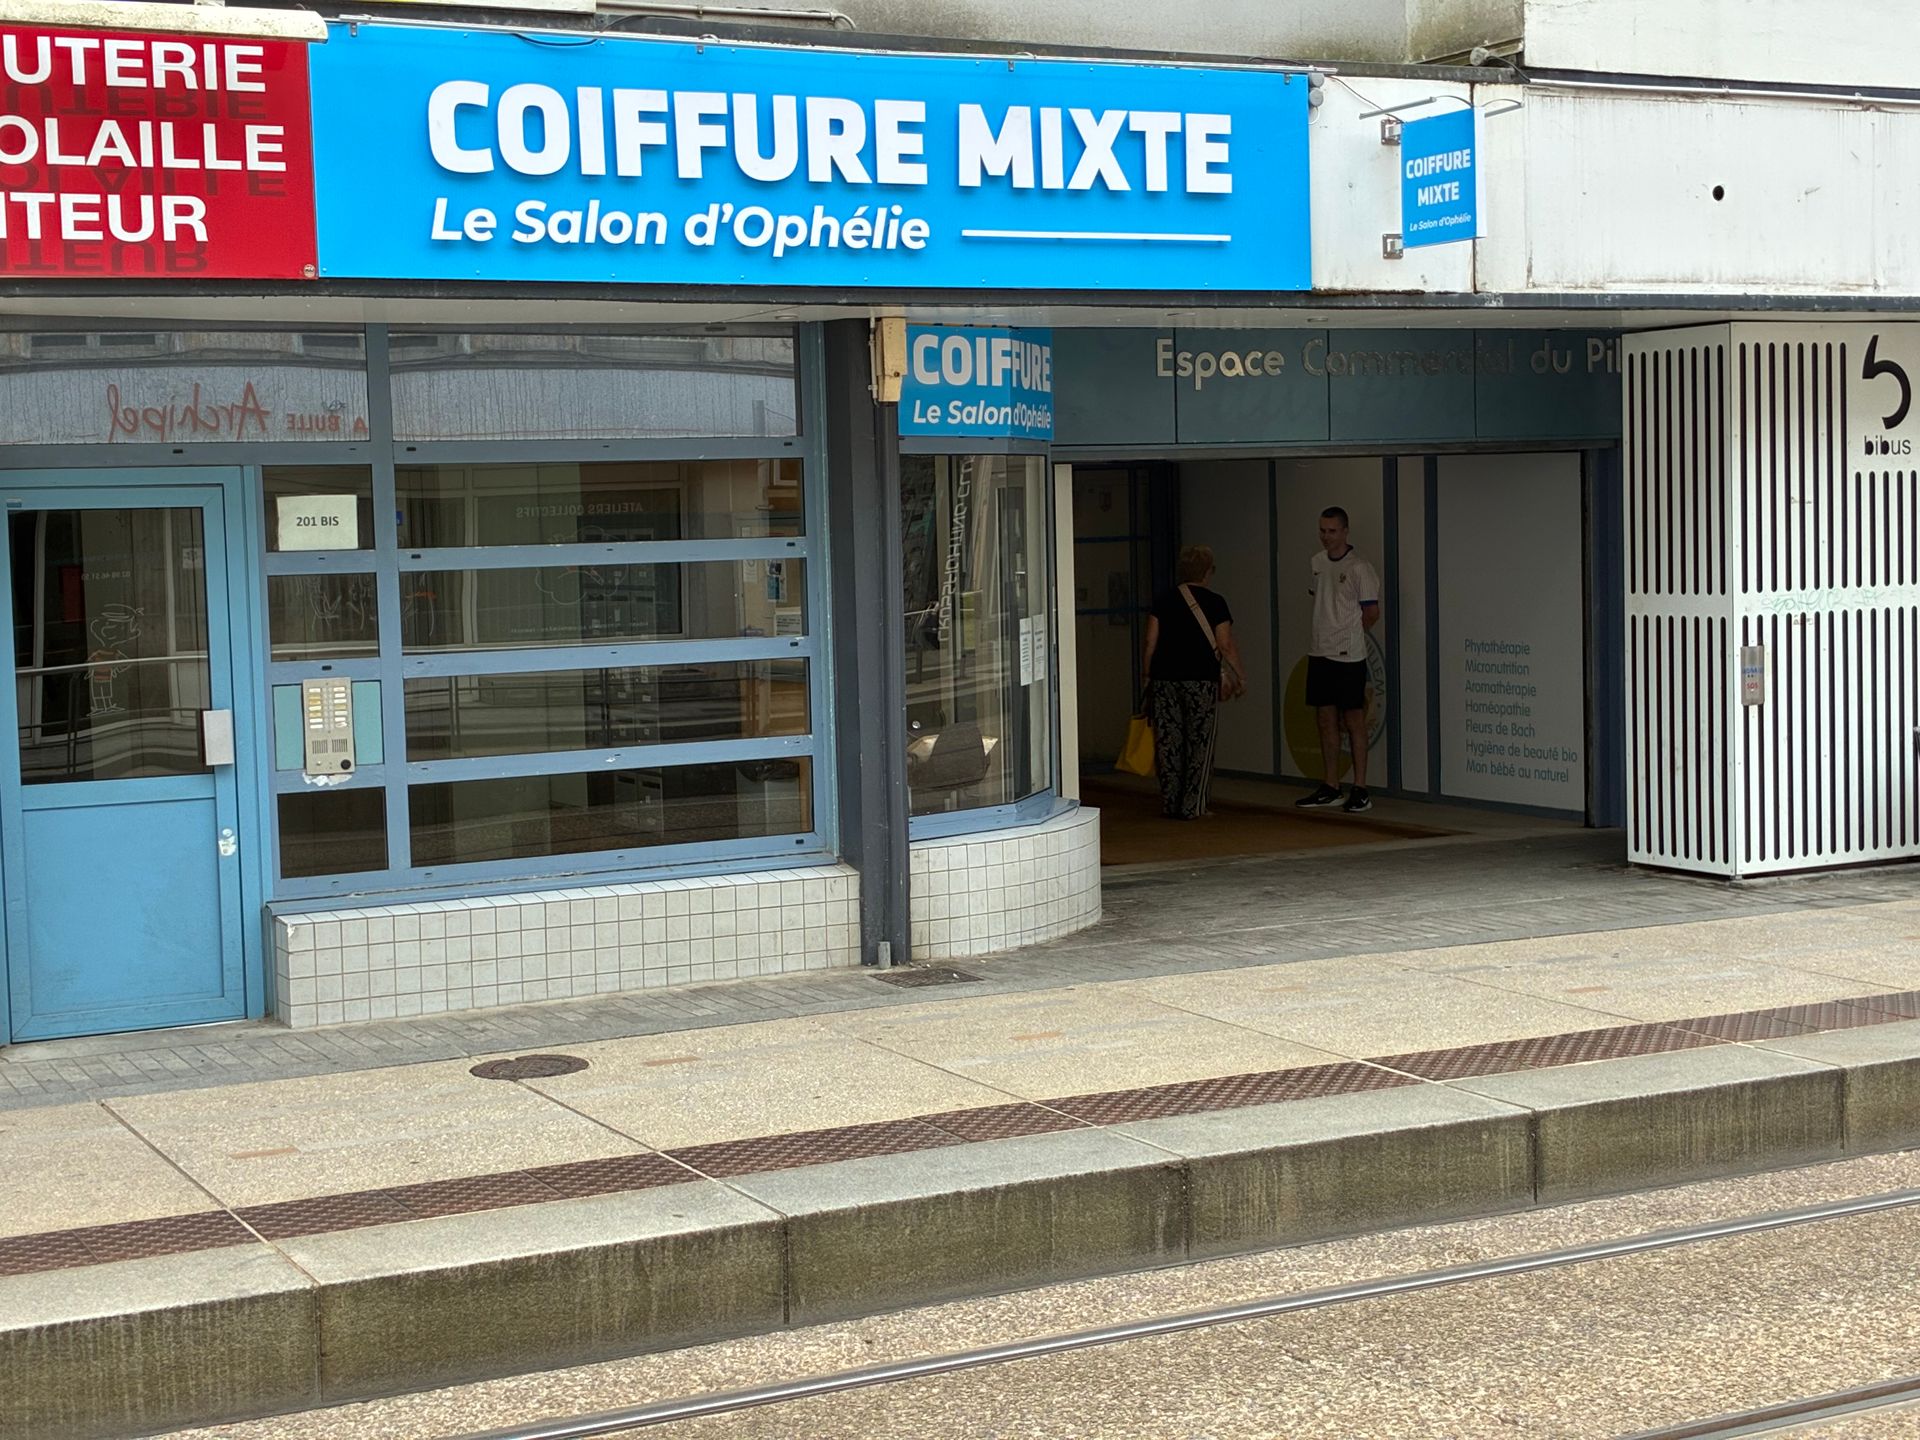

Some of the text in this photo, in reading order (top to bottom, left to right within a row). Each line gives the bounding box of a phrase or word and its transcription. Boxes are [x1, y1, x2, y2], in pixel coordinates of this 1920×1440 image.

[2, 34, 267, 93] UTERIE
[428, 80, 1233, 194] COIFFURE MIXTE
[1406, 148, 1471, 179] COIFFURE
[1417, 181, 1460, 207] MIXTE
[430, 198, 931, 258] Le Salon d'Ophélie
[1409, 222, 1418, 232] Le
[1418, 219, 1438, 230] Salon
[913, 334, 1051, 393] COIFFURE
[1155, 338, 1285, 391] Espace
[1301, 337, 1517, 377] Commercial
[1530, 339, 1572, 375] du
[913, 400, 1051, 432] Le Salon d'Ophélie
[1864, 435, 1911, 456] bibus
[295, 516, 340, 528] 201 BIS
[1464, 638, 1531, 657] Phytothérapie
[1465, 660, 1530, 675] Micronutrition
[1465, 680, 1537, 700] Aromathérapie
[1465, 700, 1531, 719] Homéopathie
[1465, 720, 1536, 738] Fleurs de Bach
[1466, 739, 1578, 762] Hygiène de beauté bio
[1466, 760, 1569, 783] Mon bébé au naturel
